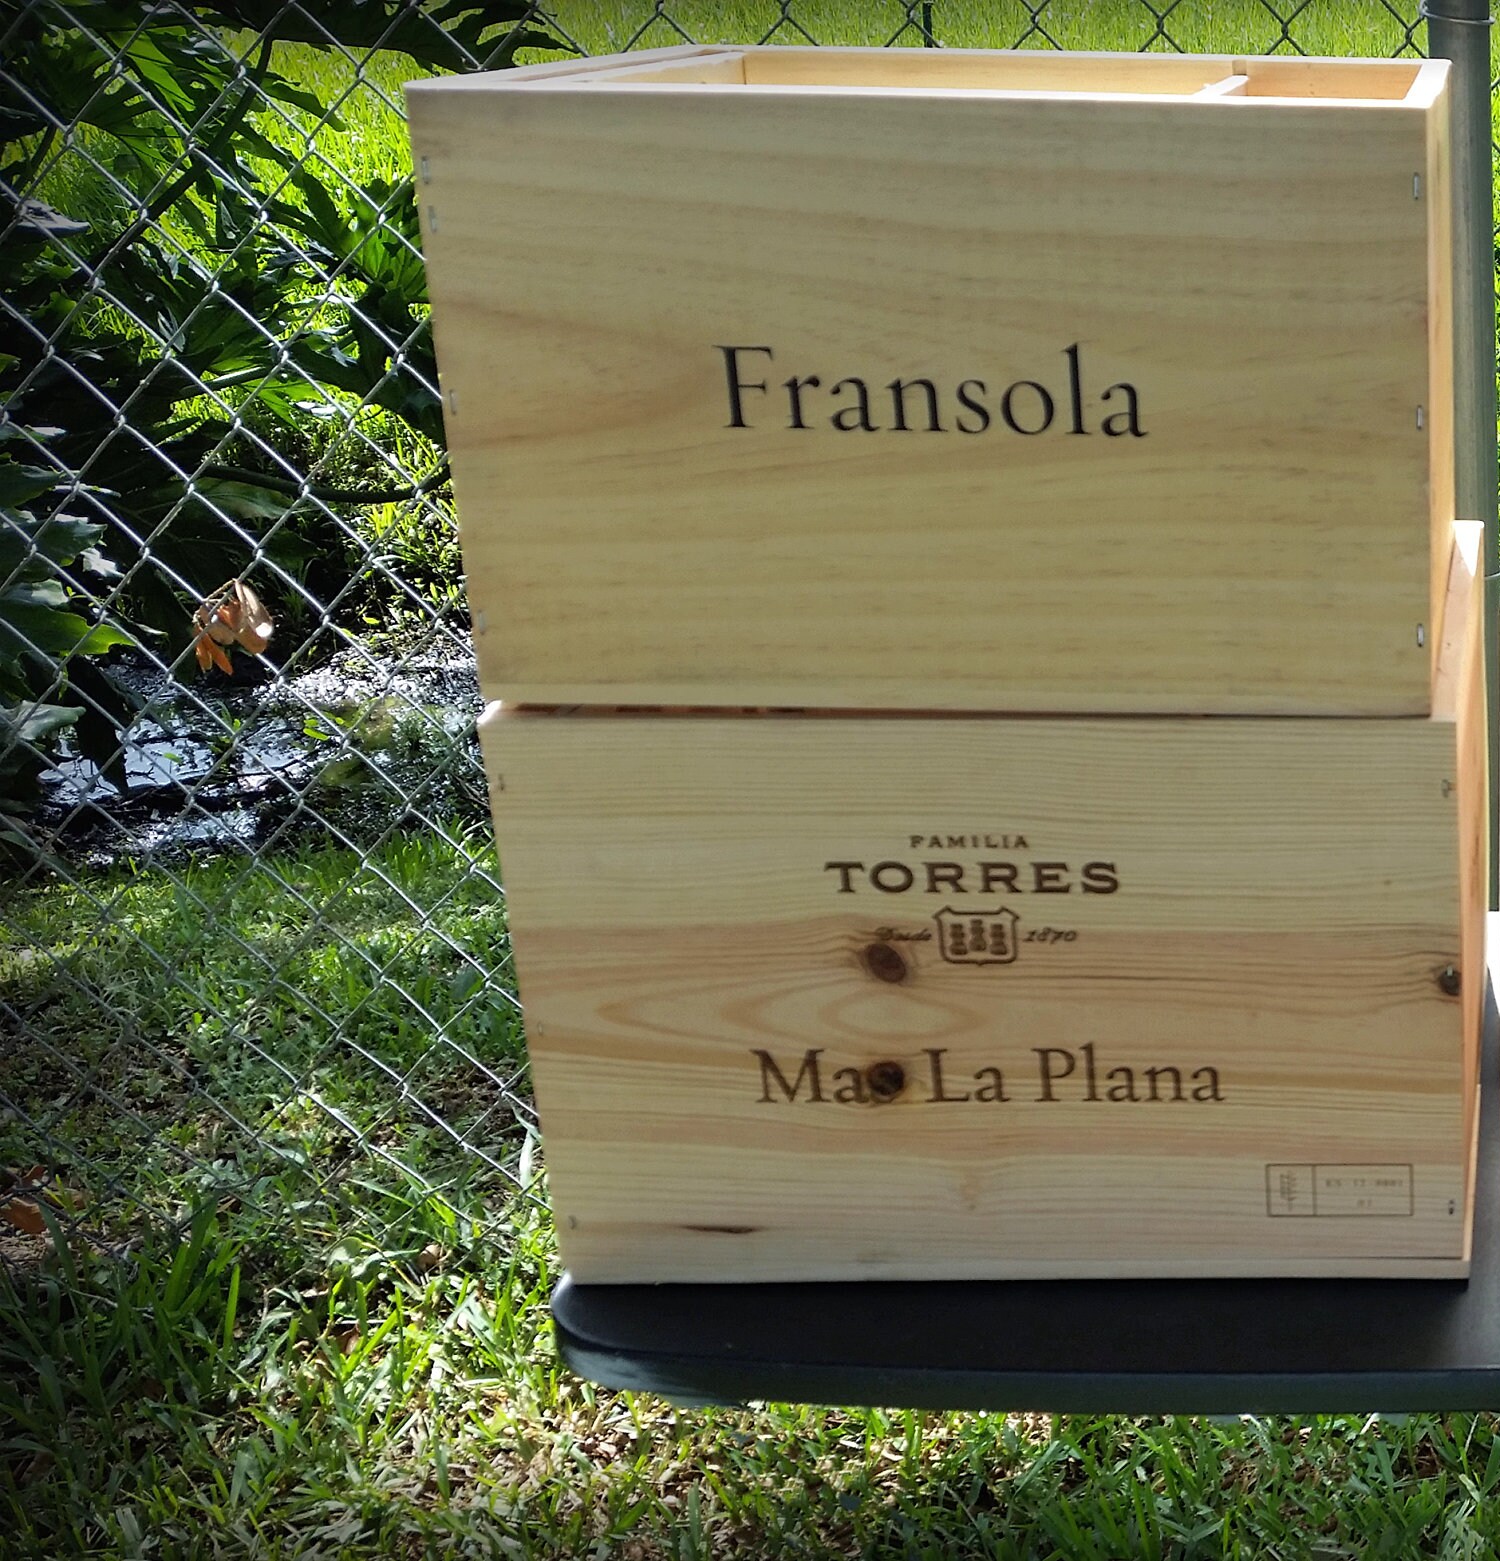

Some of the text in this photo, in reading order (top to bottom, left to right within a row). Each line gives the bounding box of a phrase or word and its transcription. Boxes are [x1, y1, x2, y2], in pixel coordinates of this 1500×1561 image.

[713, 342, 1149, 438] Fransola
[908, 834, 1030, 849] FAMILIA
[823, 861, 1120, 895] TORRES
[1023, 926, 1080, 943] 1870
[921, 1047, 1011, 1103] La
[1031, 1041, 1226, 1104] Plana
